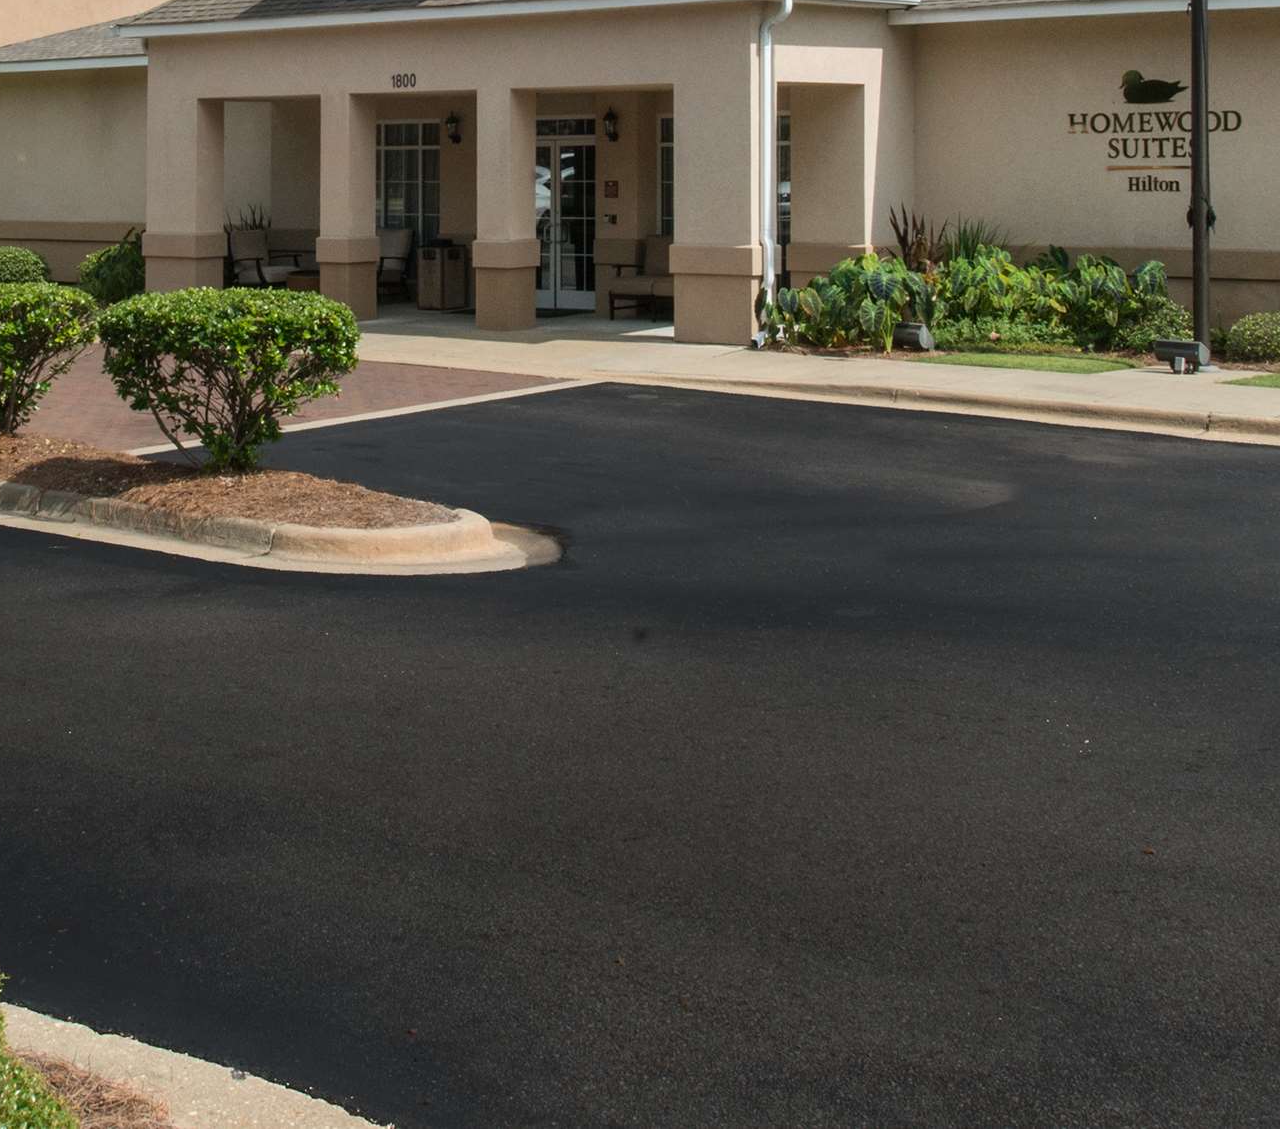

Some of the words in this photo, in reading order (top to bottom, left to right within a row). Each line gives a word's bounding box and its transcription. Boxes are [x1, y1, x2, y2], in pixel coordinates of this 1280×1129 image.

[392, 73, 417, 88] 1800
[1067, 110, 1242, 133] HOMEWOOD
[1127, 175, 1181, 192] Hilton
